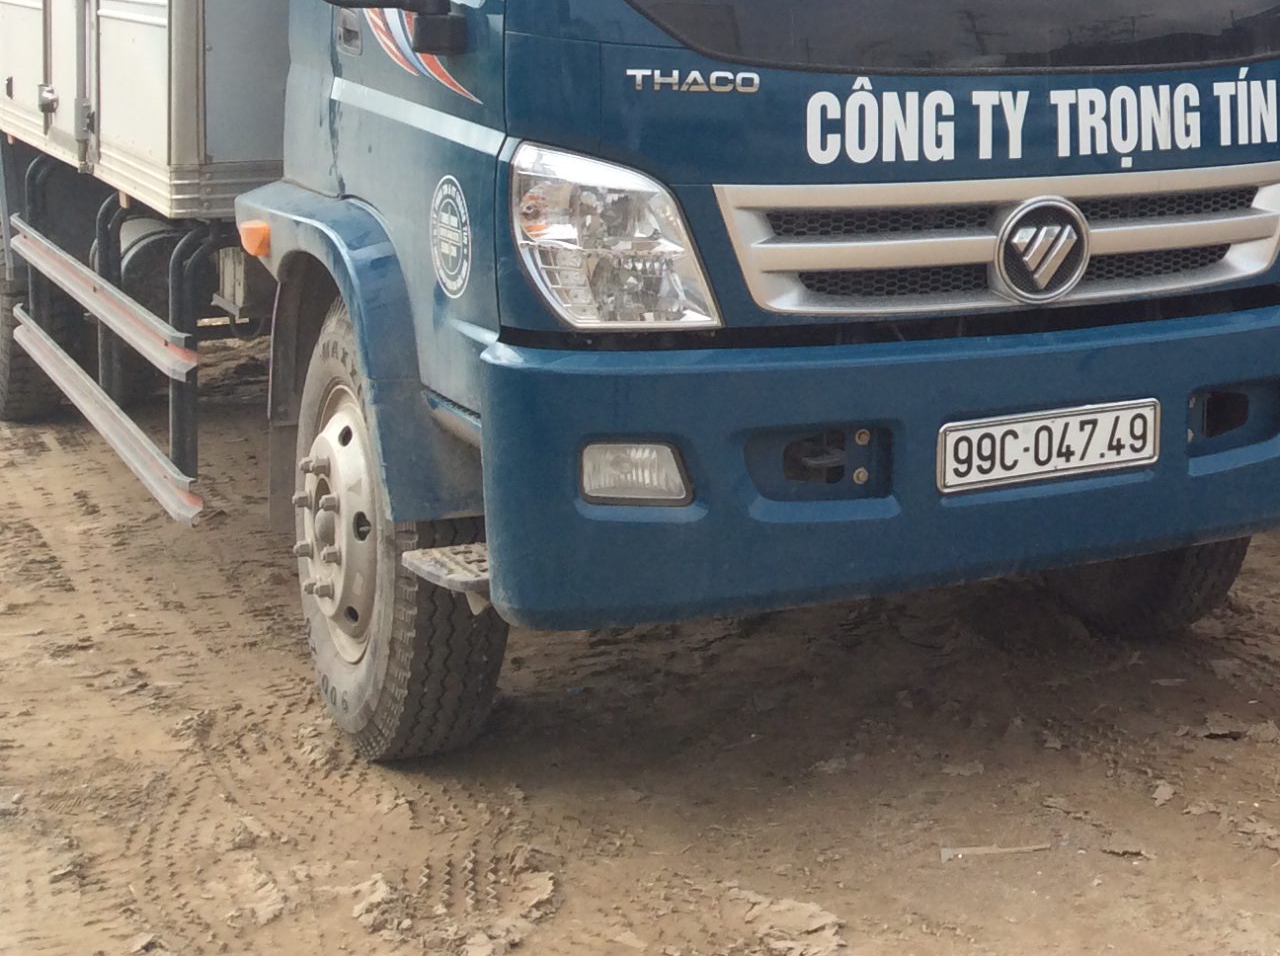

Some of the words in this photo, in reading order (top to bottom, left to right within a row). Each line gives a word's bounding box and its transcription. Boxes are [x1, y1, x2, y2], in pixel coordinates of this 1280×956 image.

[626, 69, 760, 93] THACO
[806, 76, 955, 165] CÔNG
[971, 90, 1029, 160] TY
[1049, 82, 1201, 168] TRỌNG
[1212, 67, 1278, 146] TÍN
[953, 412, 1148, 479] 99C-047.49
